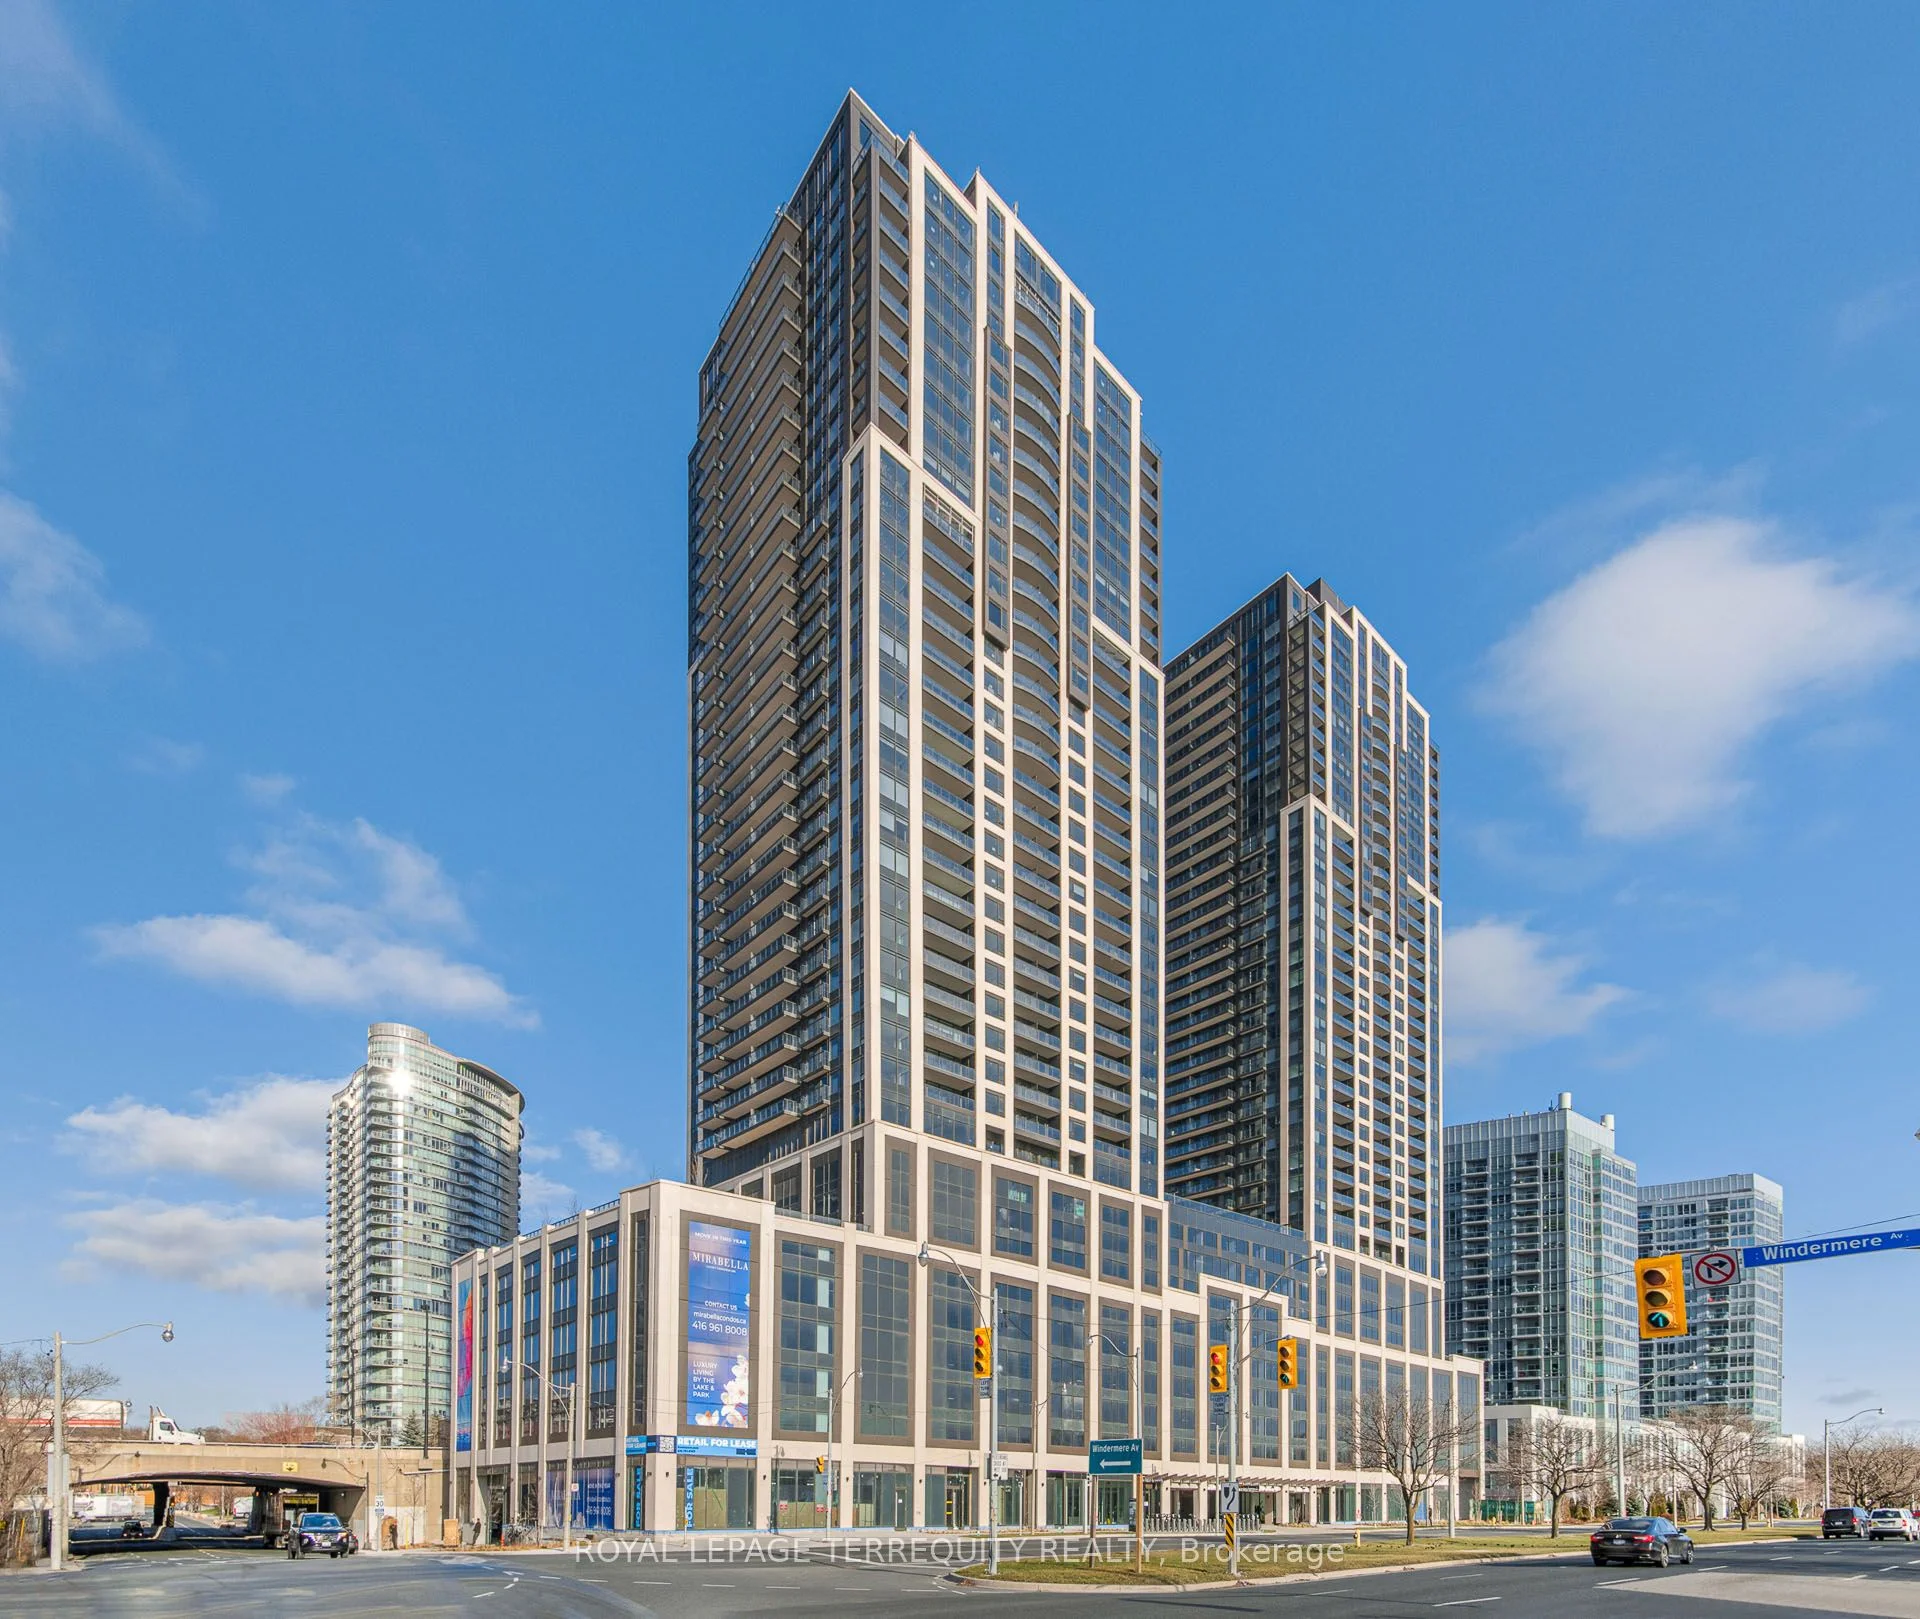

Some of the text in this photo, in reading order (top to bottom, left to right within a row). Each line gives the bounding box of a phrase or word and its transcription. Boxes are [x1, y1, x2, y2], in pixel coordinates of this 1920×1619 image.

[1762, 1232, 1903, 1261] Windermere Av
[692, 1251, 749, 1271] MIRABELLA
[704, 1300, 729, 1310] CONTACT
[693, 1311, 747, 1325] mirabellacondos.ca
[692, 1320, 748, 1337] 416 961 8008
[693, 1360, 718, 1369] LUXURY
[693, 1369, 714, 1377] LIVING
[677, 1437, 757, 1448] RETAIL FOR LEASE
[1092, 1443, 1139, 1453] Windermere Av
[686, 1468, 694, 1499] SALE
